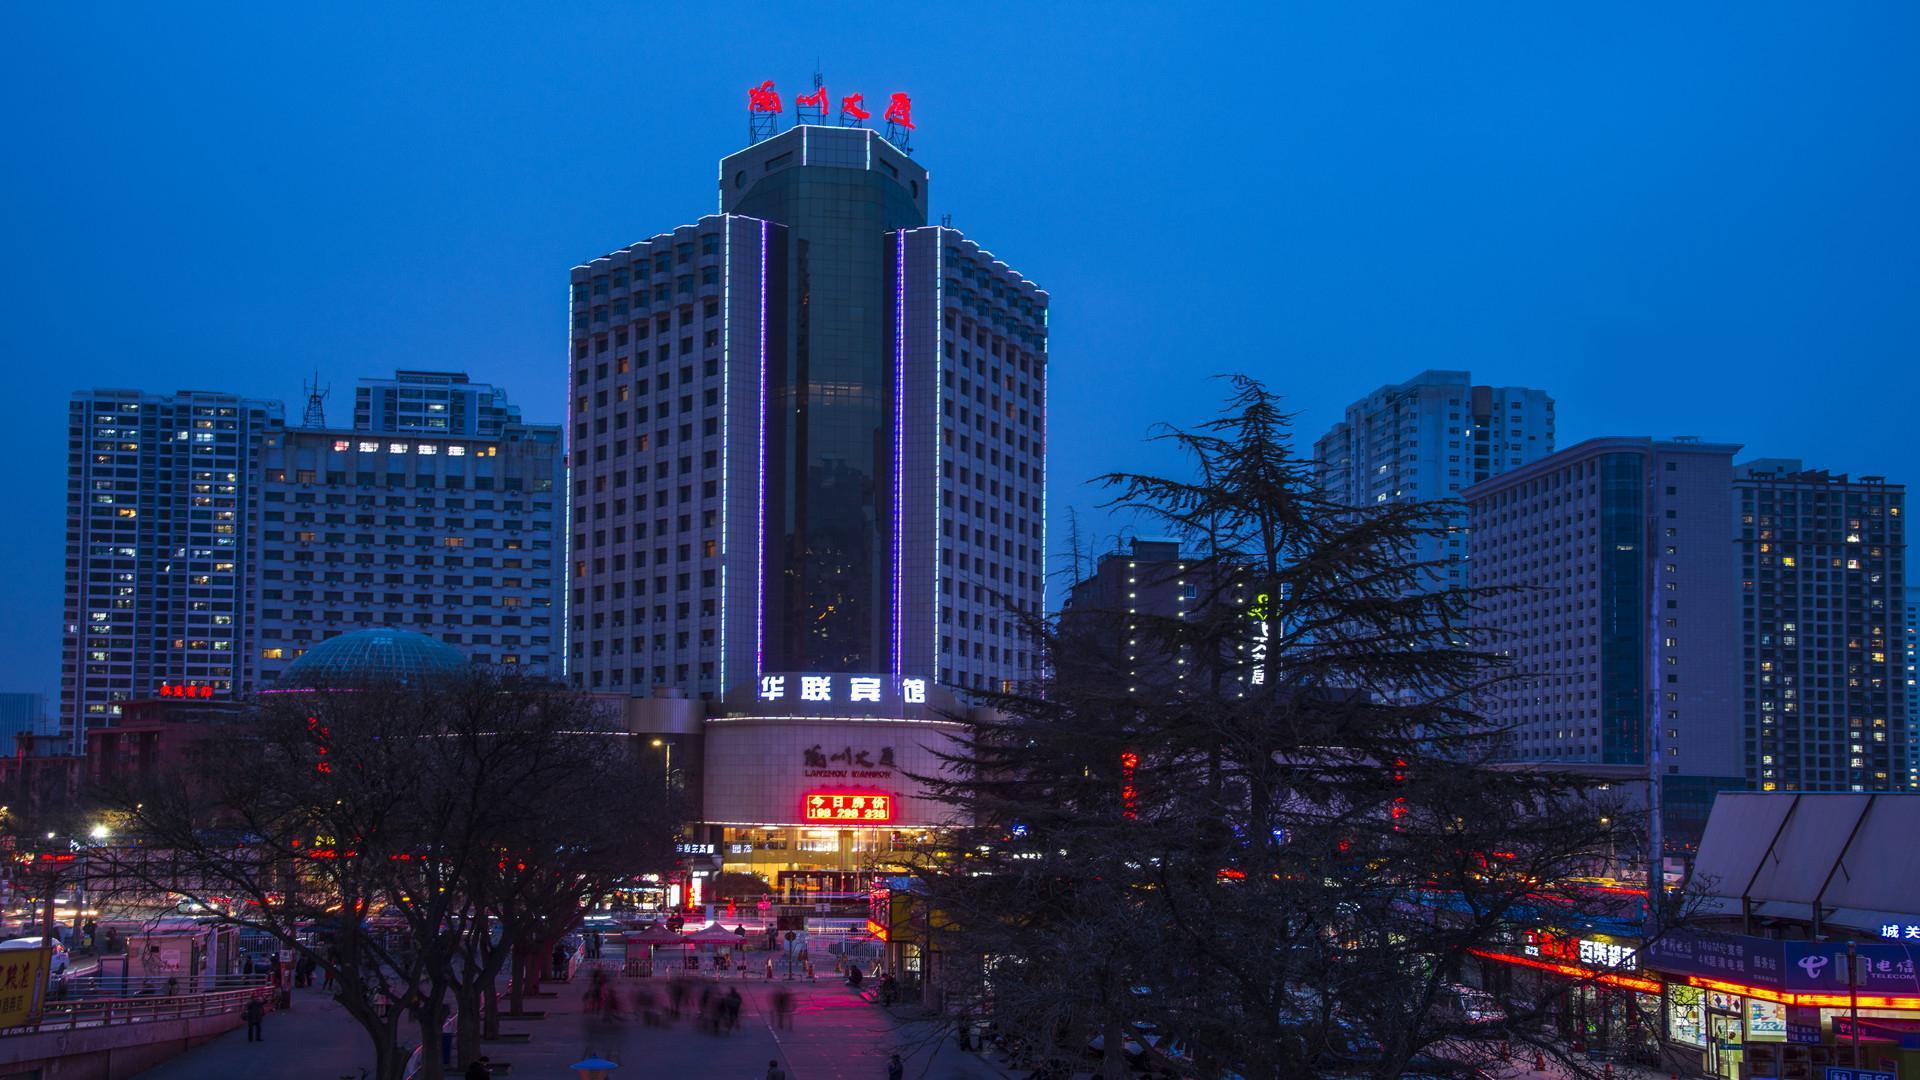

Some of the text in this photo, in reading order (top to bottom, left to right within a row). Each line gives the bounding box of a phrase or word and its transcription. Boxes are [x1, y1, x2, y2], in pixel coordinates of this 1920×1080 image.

[760, 675, 926, 703] 华联宾馆
[805, 769, 848, 778] LANZHOU
[810, 796, 886, 809] 今日房价
[1579, 939, 1637, 971] 百货超市
[1753, 954, 1777, 971] 服务站
